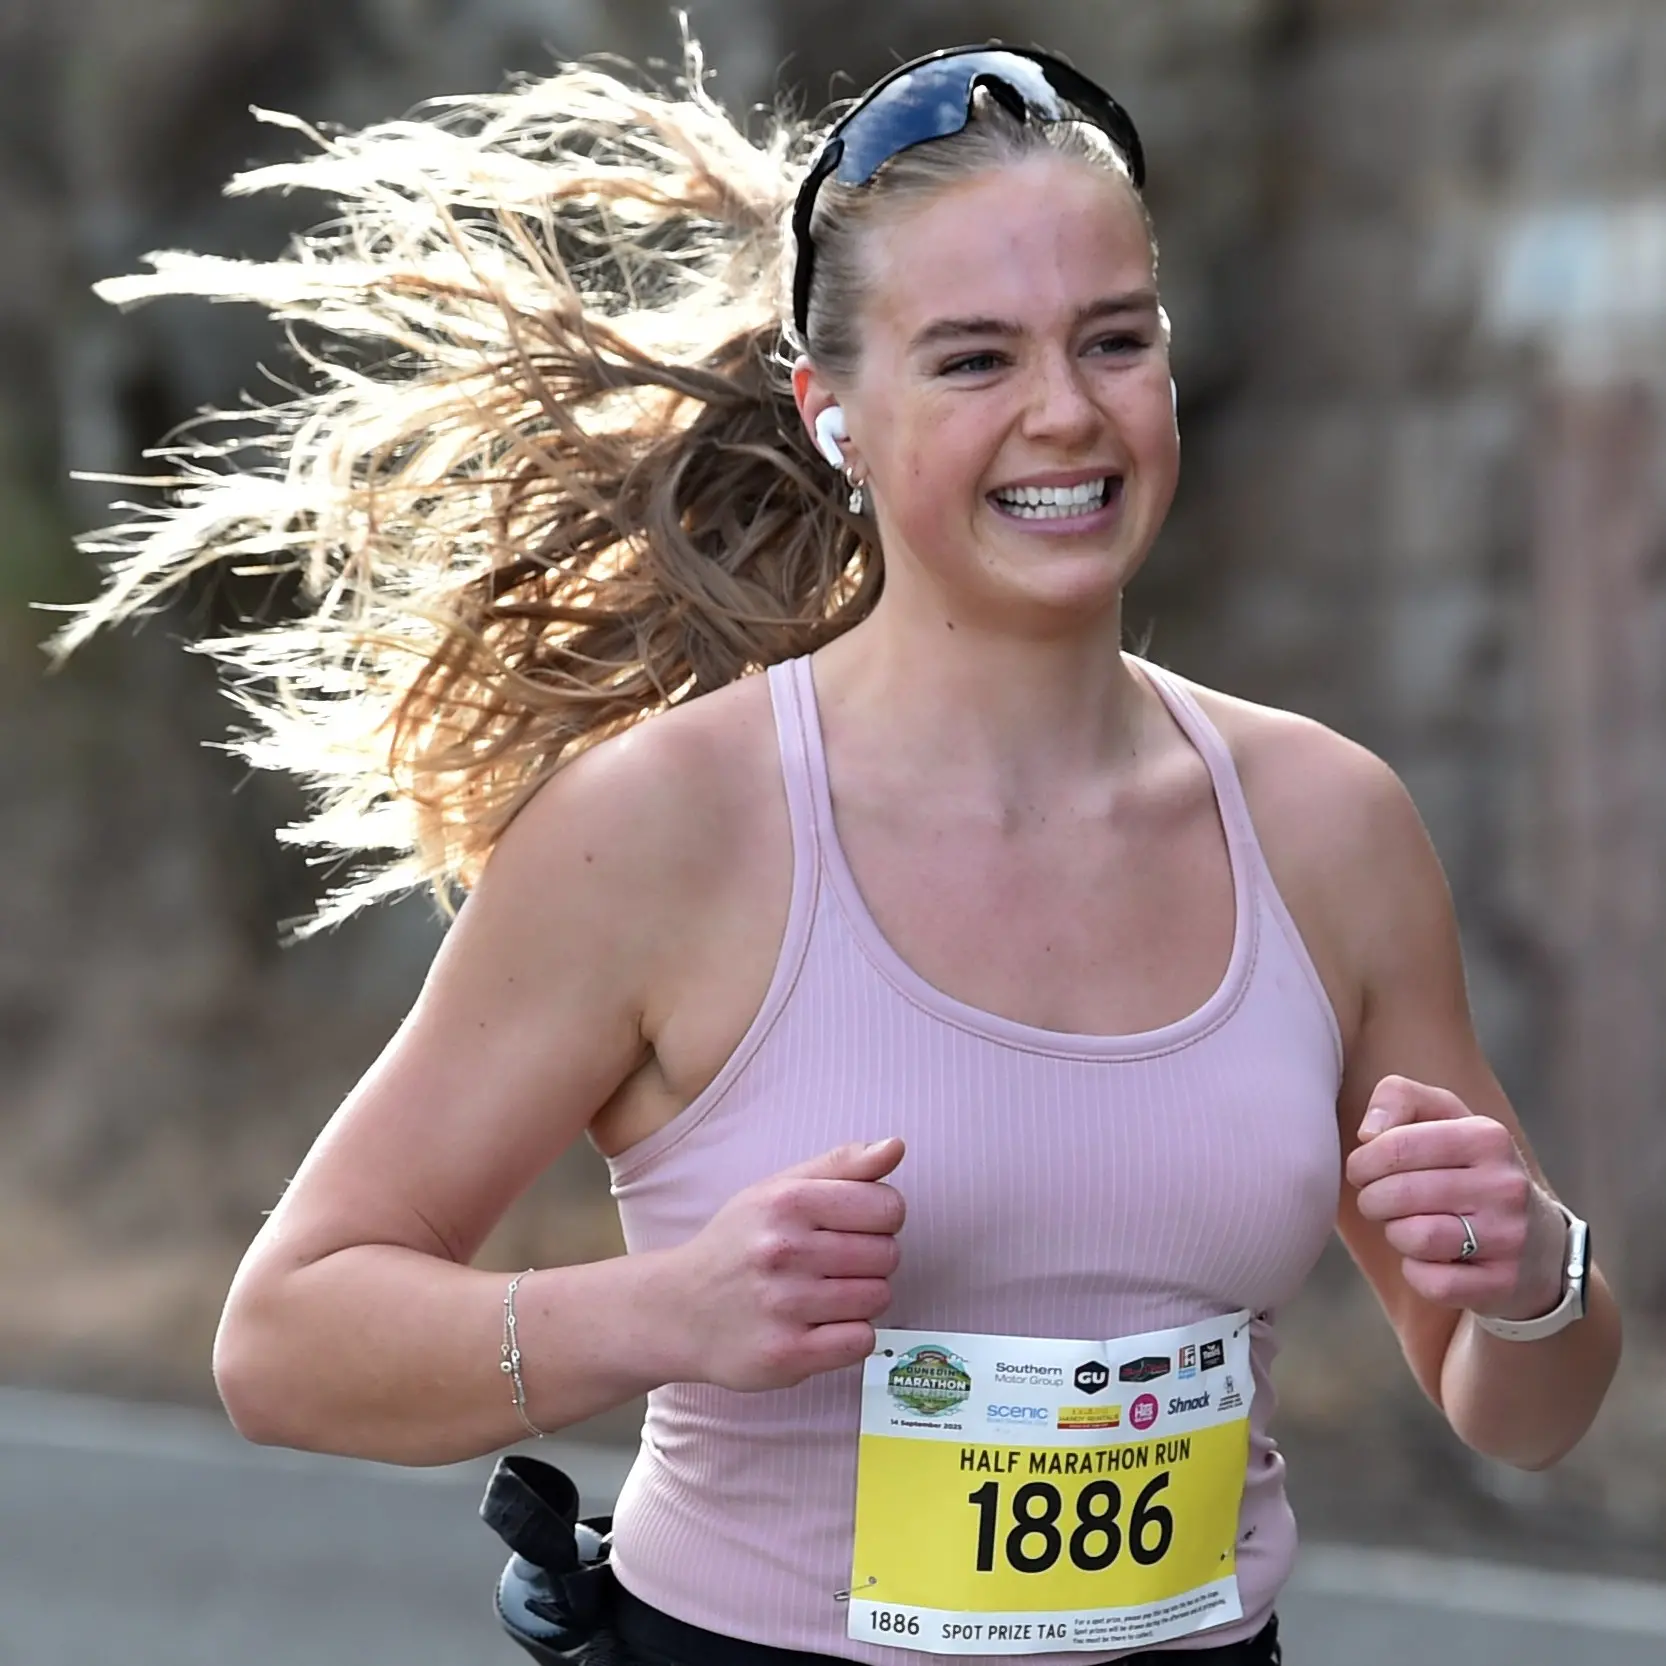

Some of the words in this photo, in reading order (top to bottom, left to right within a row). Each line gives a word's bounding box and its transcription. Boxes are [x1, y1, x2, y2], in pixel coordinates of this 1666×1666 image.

[906, 1366, 957, 1376] DUNEDIN
[995, 1362, 1063, 1375] Southern
[893, 1376, 966, 1390] MARATHON
[994, 1374, 1026, 1383] Motor
[1029, 1375, 1064, 1387] Group
[1077, 1371, 1106, 1384] GU
[1167, 1390, 1210, 1415] Shnack
[900, 1420, 941, 1428] September
[943, 1422, 963, 1430] 2025
[960, 1448, 1021, 1473] HALF
[1028, 1445, 1149, 1475] MARATHON
[1155, 1437, 1191, 1466] RUN
[968, 1470, 1173, 1574] 1886
[870, 1610, 920, 1636] 1886
[942, 1624, 983, 1640] SPOT
[988, 1624, 1033, 1641] PRIZE
[1037, 1623, 1067, 1639] TAG
